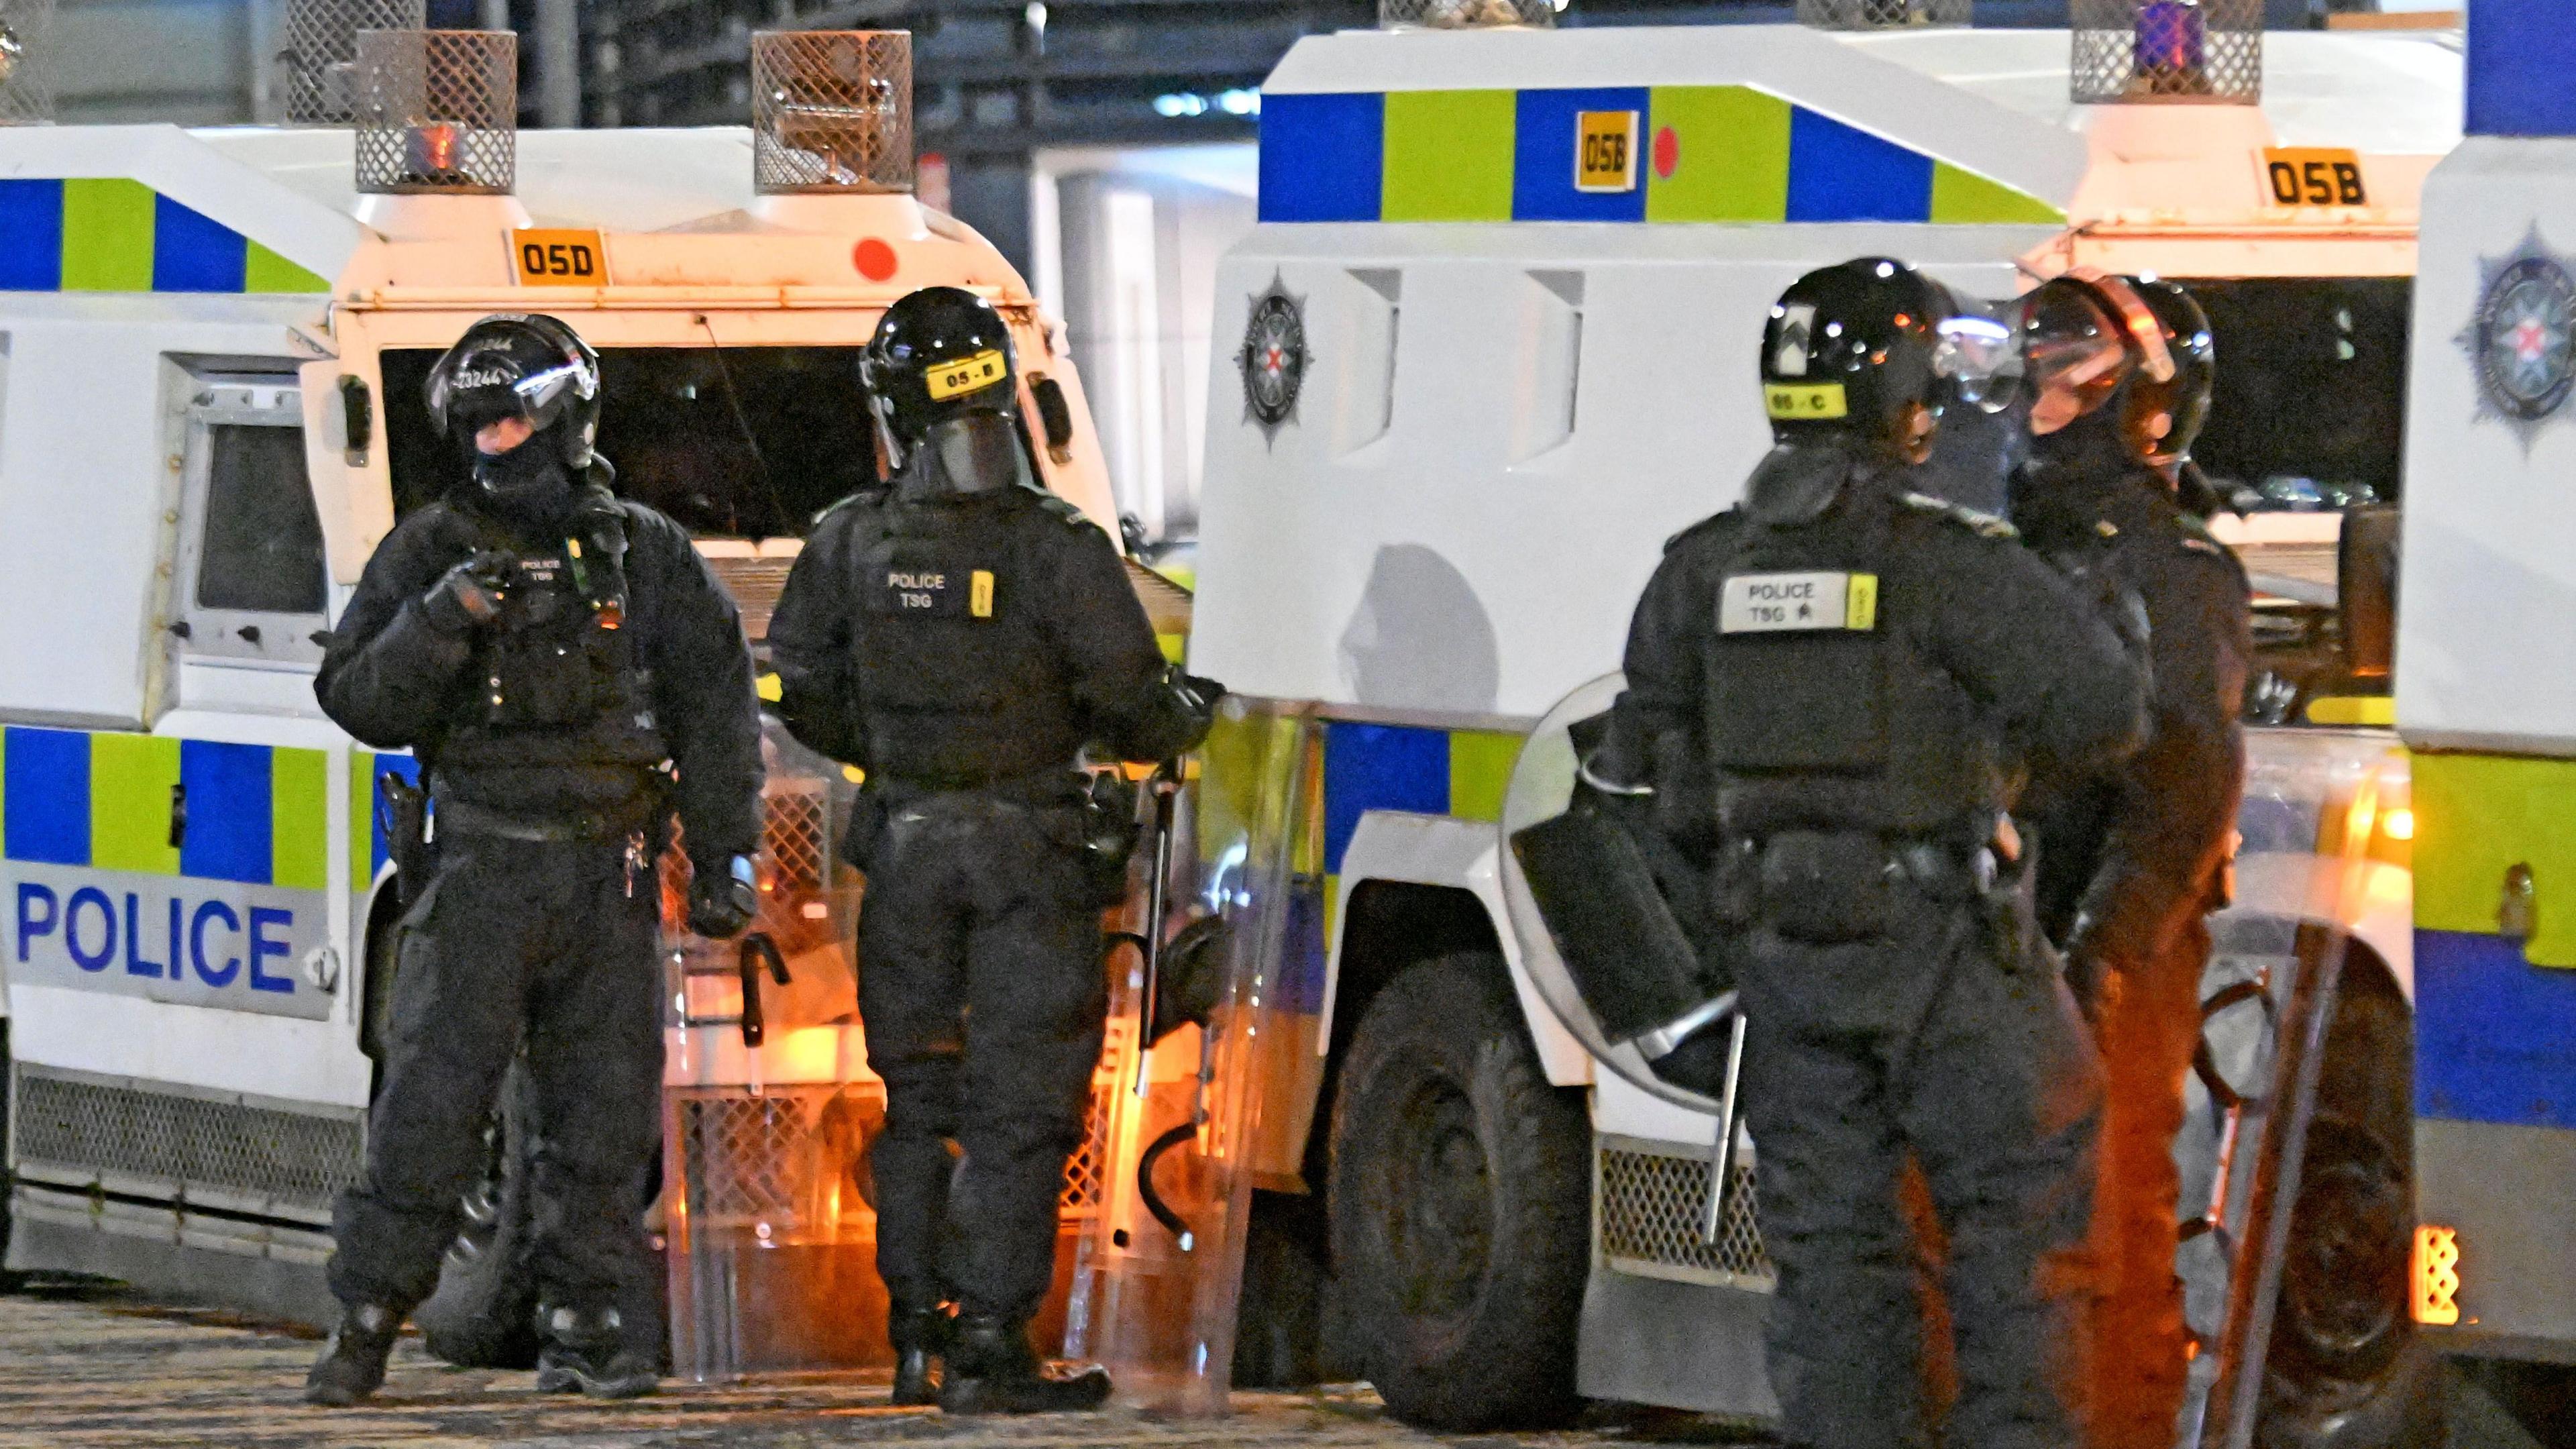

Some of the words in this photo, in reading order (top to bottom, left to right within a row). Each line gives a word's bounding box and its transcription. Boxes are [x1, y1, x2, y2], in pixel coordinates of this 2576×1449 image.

[1587, 134, 1626, 171] 05B
[2269, 161, 2366, 205] 05B
[524, 244, 594, 276] 05D
[888, 574, 946, 590] POLICE
[1750, 583, 1814, 600] POLICE
[900, 592, 933, 608] TSG
[1750, 606, 1786, 623] TSG
[18, 882, 295, 993] POLICE
